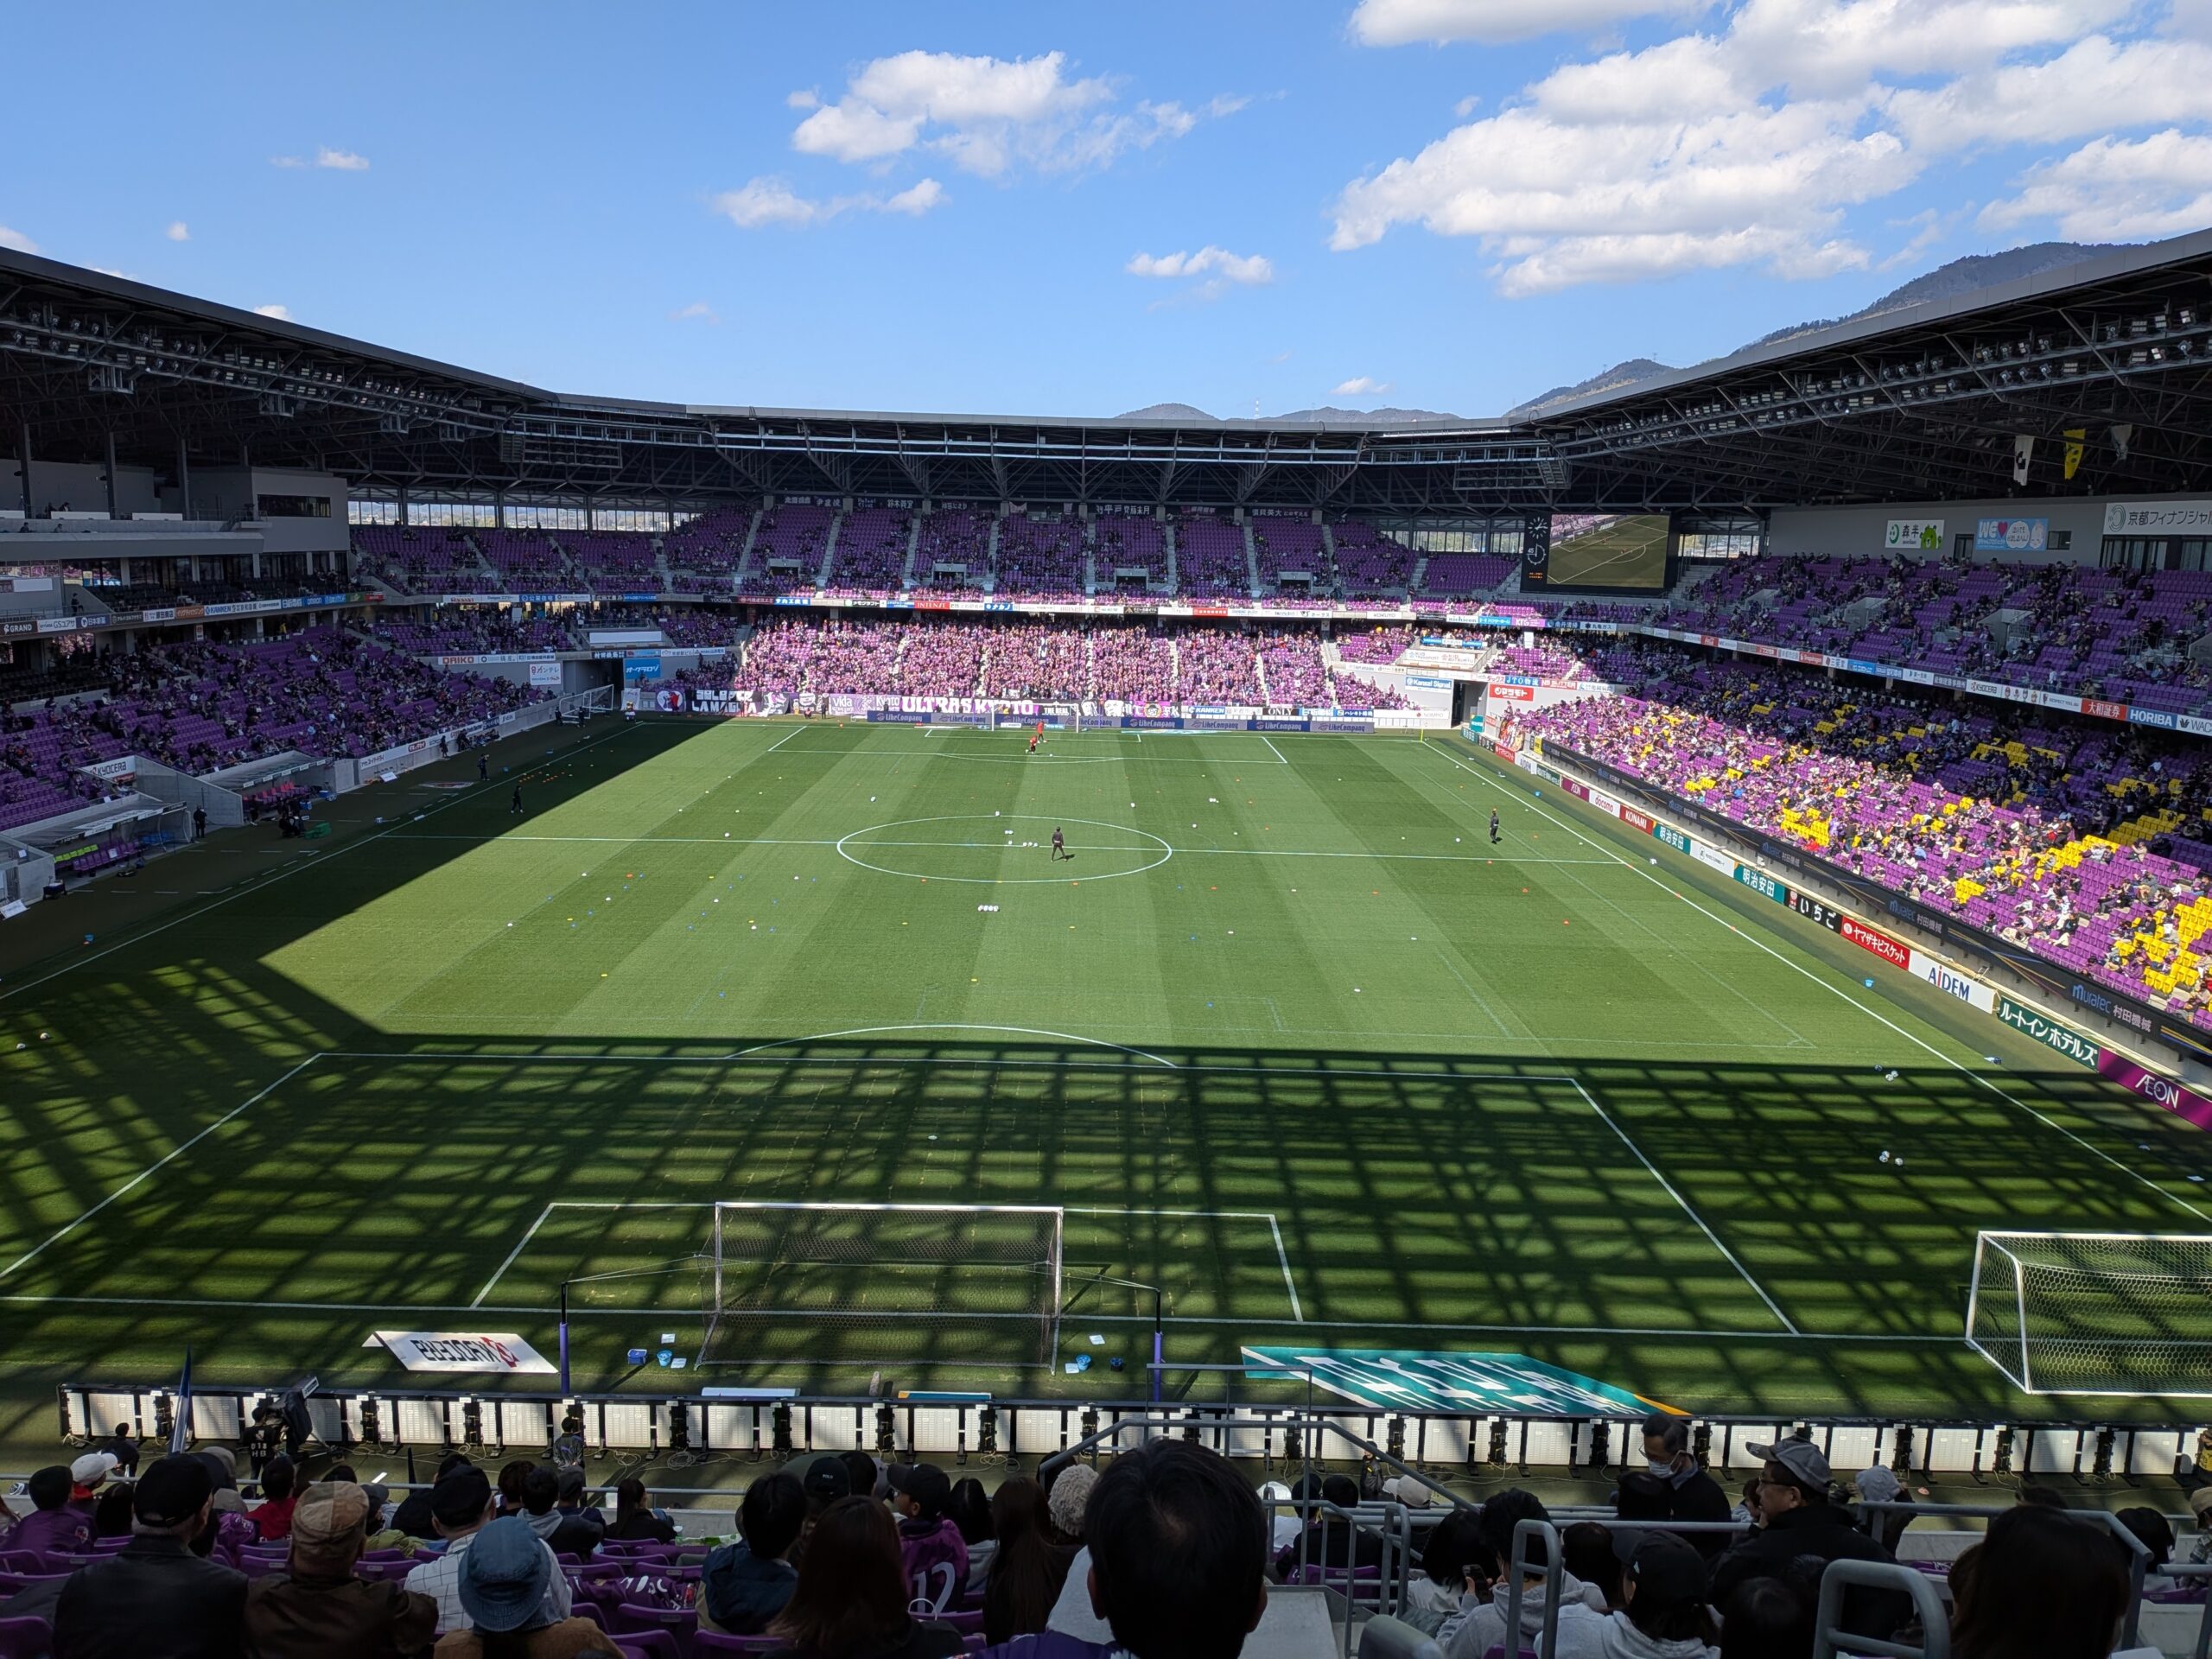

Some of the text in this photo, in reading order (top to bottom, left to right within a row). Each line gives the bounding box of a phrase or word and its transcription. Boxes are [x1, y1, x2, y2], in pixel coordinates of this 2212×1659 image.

[442, 656, 474, 664] DAIKO
[901, 696, 972, 713] ULTRAS
[2088, 701, 2120, 718] 大和証券
[2129, 709, 2173, 727] HORIBA
[97, 760, 127, 776] KYOCERA
[1595, 796, 1614, 813] docomo
[1625, 808, 1647, 830] KONAMI
[1659, 825, 1685, 850] 明治安田
[1742, 867, 1776, 898] 明治安田
[1800, 897, 1837, 930] いちご
[1916, 913, 1942, 935] 村田機械
[1853, 926, 1906, 964] ヤマザキビスケット
[2113, 1004, 2152, 1033] 村田機械
[410, 1338, 501, 1363] KYOCERA
[912, 1560, 957, 1614] 12
